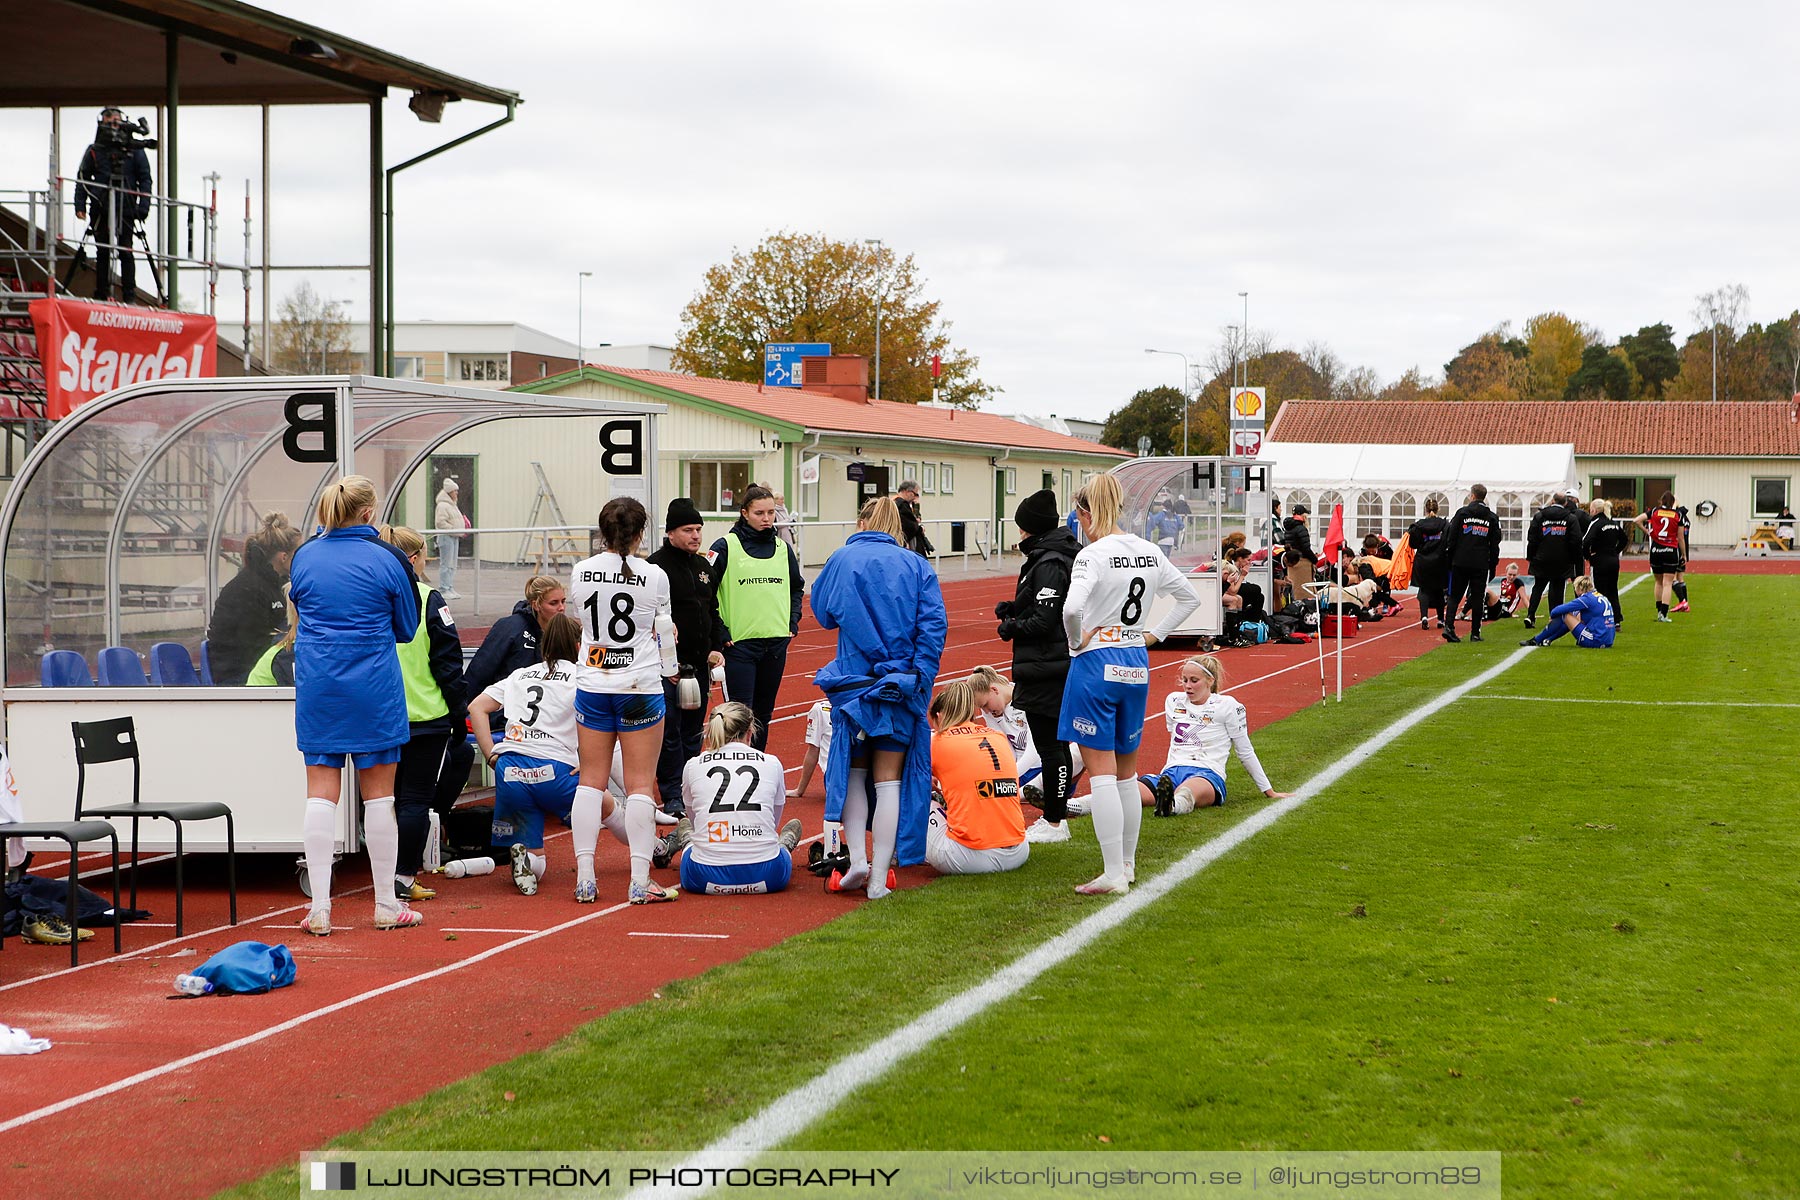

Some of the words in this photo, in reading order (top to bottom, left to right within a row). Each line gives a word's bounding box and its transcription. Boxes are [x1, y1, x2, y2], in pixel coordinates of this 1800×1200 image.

[88, 310, 184, 334] MASKINUTHYRNING
[58, 330, 204, 393] Stavdal
[599, 420, 642, 474] B
[1193, 463, 1215, 489] H
[1245, 468, 1265, 491] H
[1658, 517, 1669, 537] 2
[1113, 556, 1159, 568] BOLIDEN
[583, 571, 647, 587] BOLIDEN
[1121, 577, 1146, 626] 8
[583, 591, 636, 644] 18
[603, 652, 633, 665] Home
[1112, 667, 1144, 678] Scandic
[519, 685, 544, 727] 3
[703, 752, 765, 763] BOLIDEN
[978, 737, 1001, 770] 1
[511, 767, 548, 779] Scandic
[706, 765, 762, 813] 22
[731, 824, 763, 837] Home
[713, 885, 760, 895] Scandic
